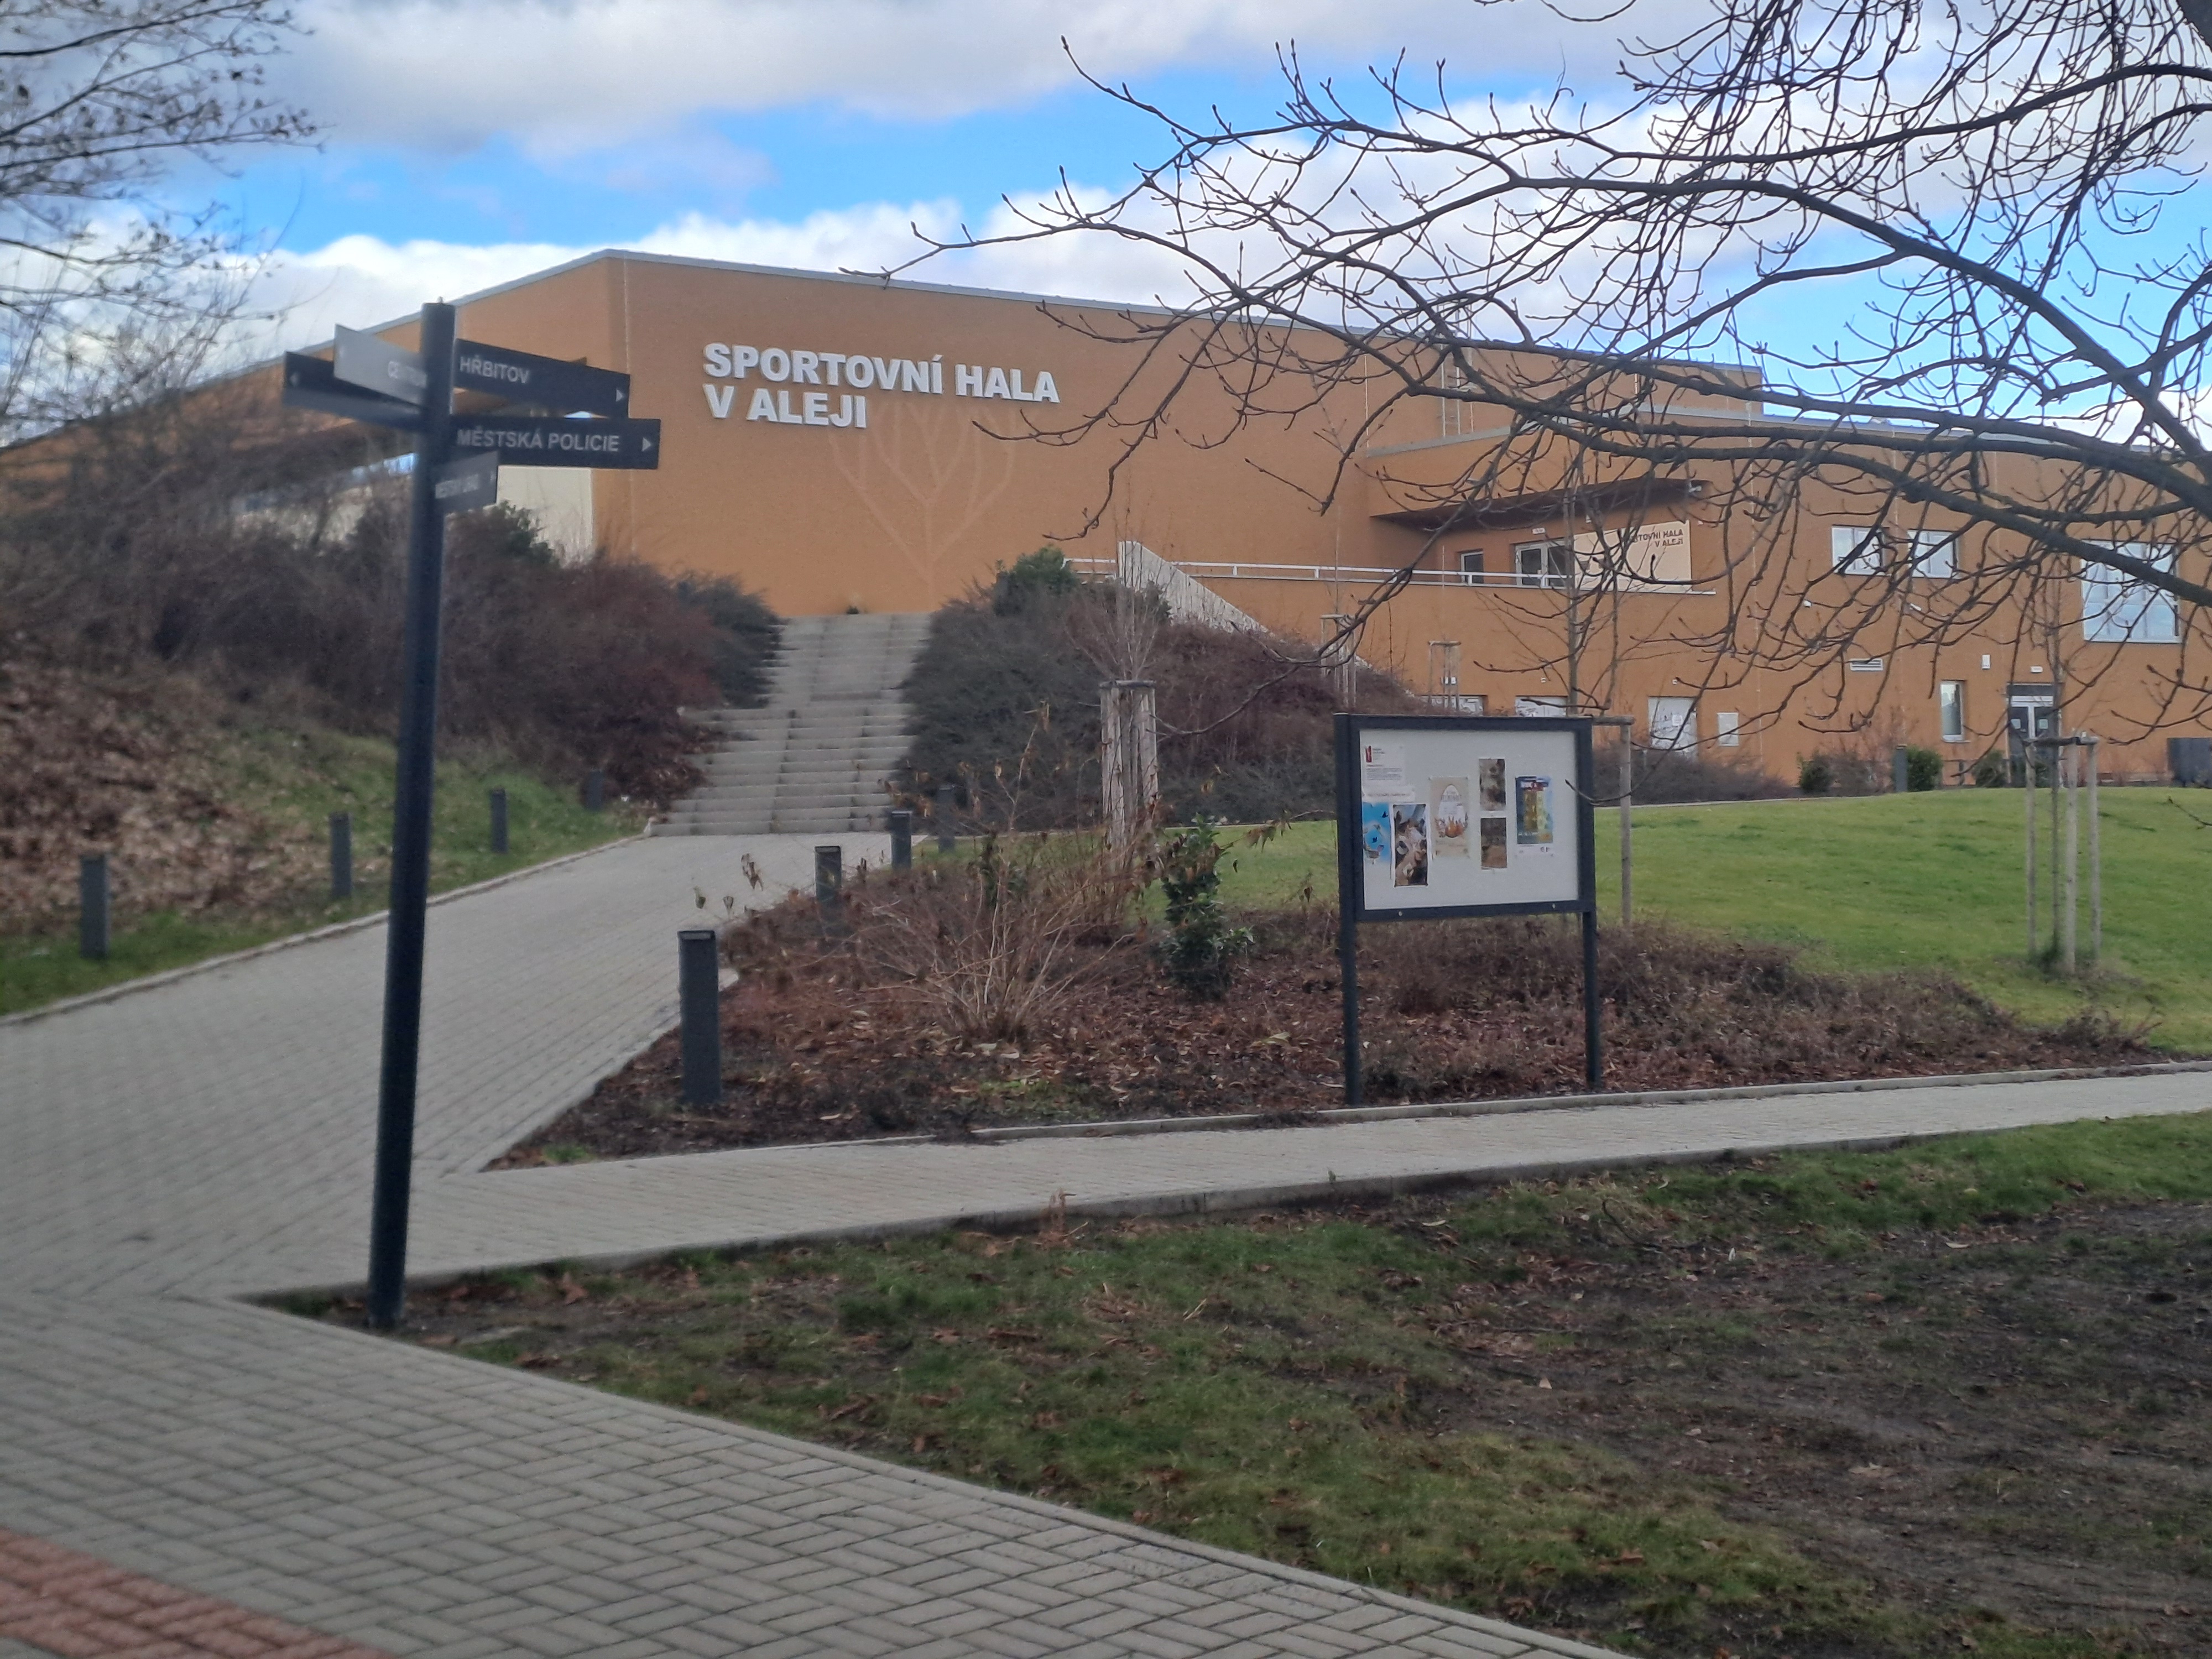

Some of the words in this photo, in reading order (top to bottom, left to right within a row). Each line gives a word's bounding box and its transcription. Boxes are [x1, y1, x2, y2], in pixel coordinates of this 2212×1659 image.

[460, 356, 531, 383] HŘBITOV
[703, 342, 943, 394] SPORTOVNÍ
[954, 363, 1060, 404] HALA
[703, 384, 736, 419] V
[746, 388, 867, 429] ALEJI
[457, 426, 542, 449] MĚSTSKÁ
[547, 432, 619, 451] POLICIE
